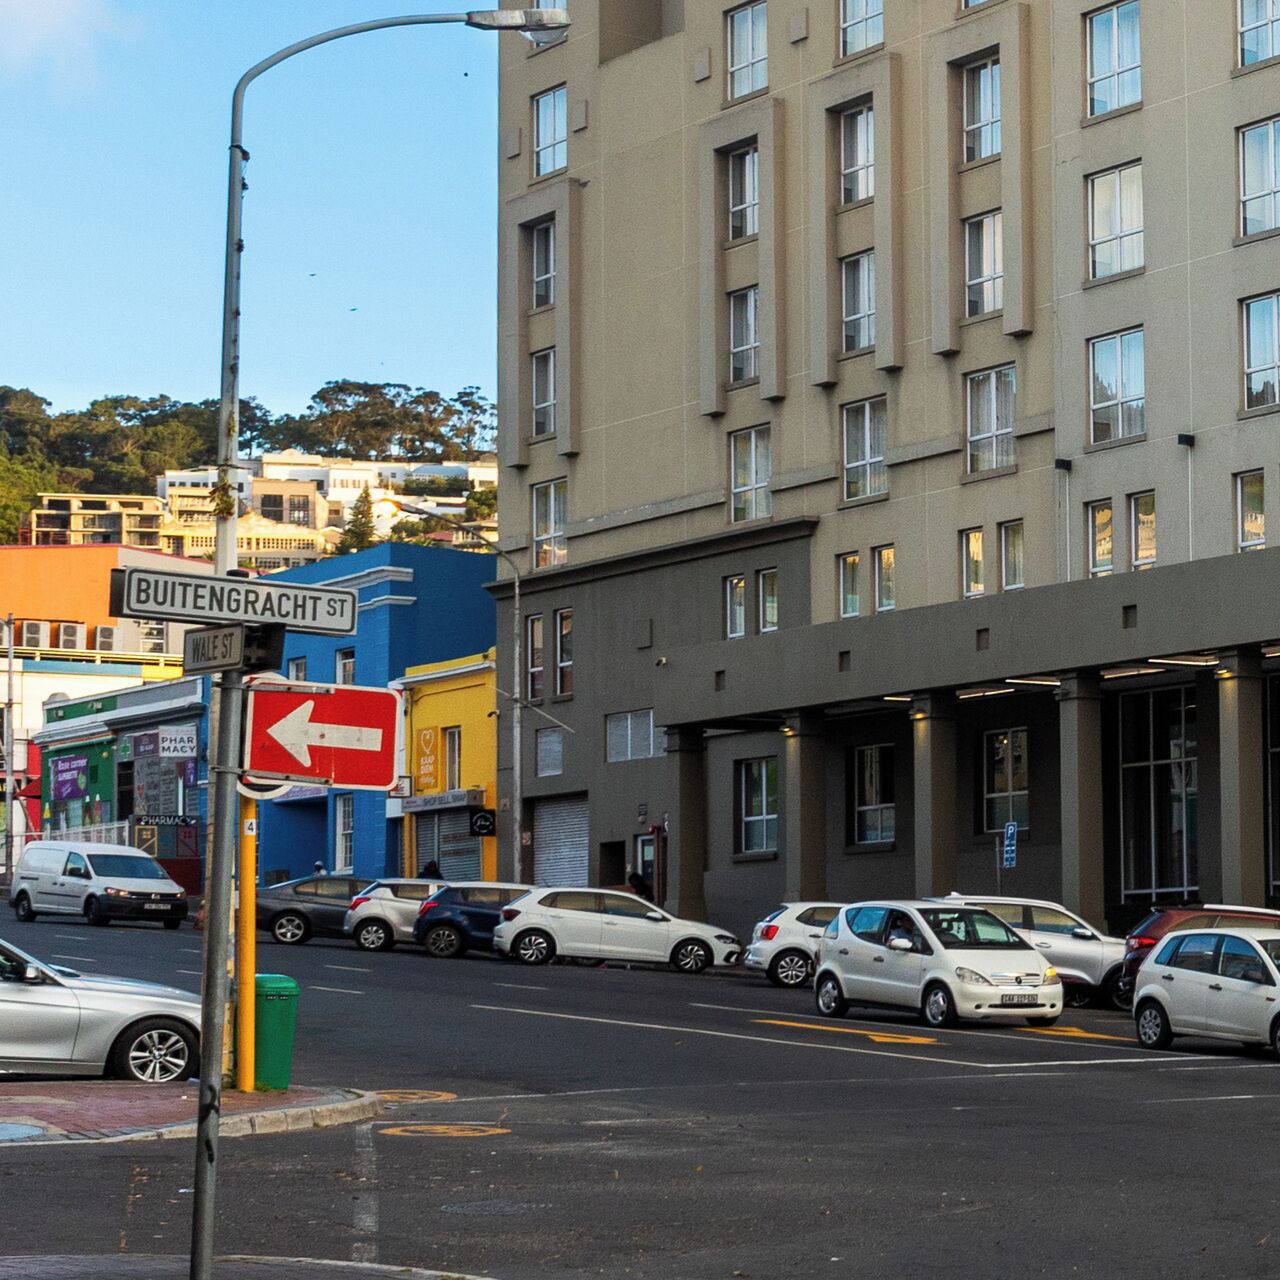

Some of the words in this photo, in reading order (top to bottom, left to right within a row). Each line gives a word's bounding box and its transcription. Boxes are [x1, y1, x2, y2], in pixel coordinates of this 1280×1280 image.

[135, 577, 322, 622] BUITENGRACHT
[326, 598, 348, 618] ST
[191, 634, 218, 663] WALE
[221, 632, 235, 658] ST
[161, 736, 195, 745] PHAR
[161, 745, 196, 754] MACY
[142, 815, 192, 825] PHARMACY
[247, 822, 254, 833] 4
[1008, 826, 1015, 837] P
